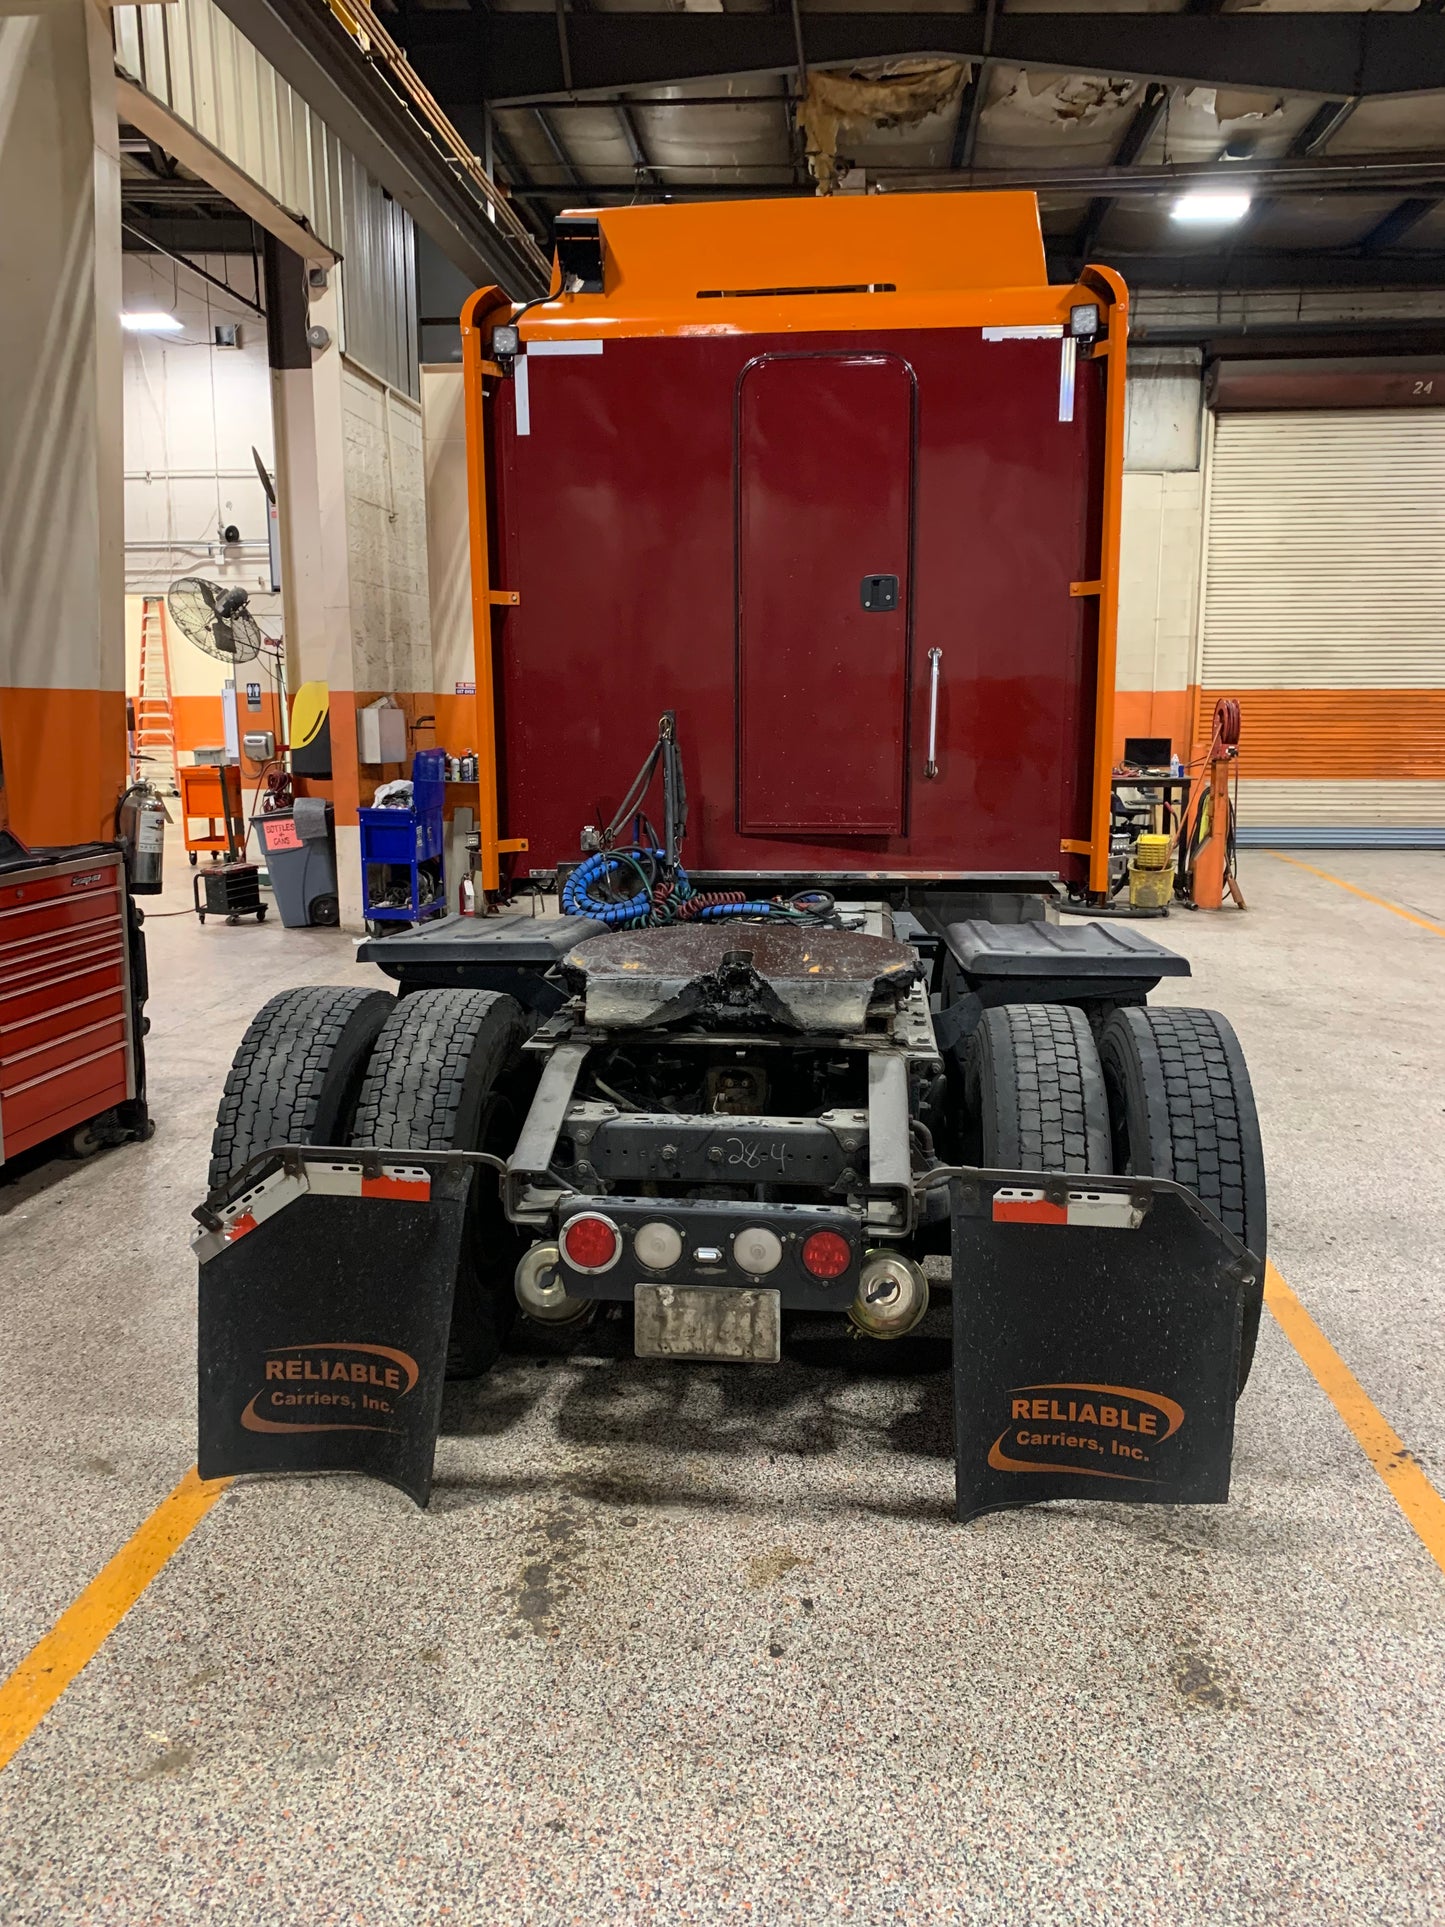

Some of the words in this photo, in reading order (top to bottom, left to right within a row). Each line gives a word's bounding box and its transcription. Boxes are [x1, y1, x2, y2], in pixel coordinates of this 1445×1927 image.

[1412, 380, 1433, 394] 24
[265, 823, 295, 833] BOTTLES
[273, 836, 290, 846] CANS
[265, 1360, 400, 1390] RELIABLE
[271, 1391, 356, 1409] Carriers,
[362, 1394, 395, 1414] Inc.
[1011, 1399, 1157, 1436] RELIABLE
[1016, 1430, 1104, 1455] Carriers,
[1111, 1440, 1150, 1462] Inc.
